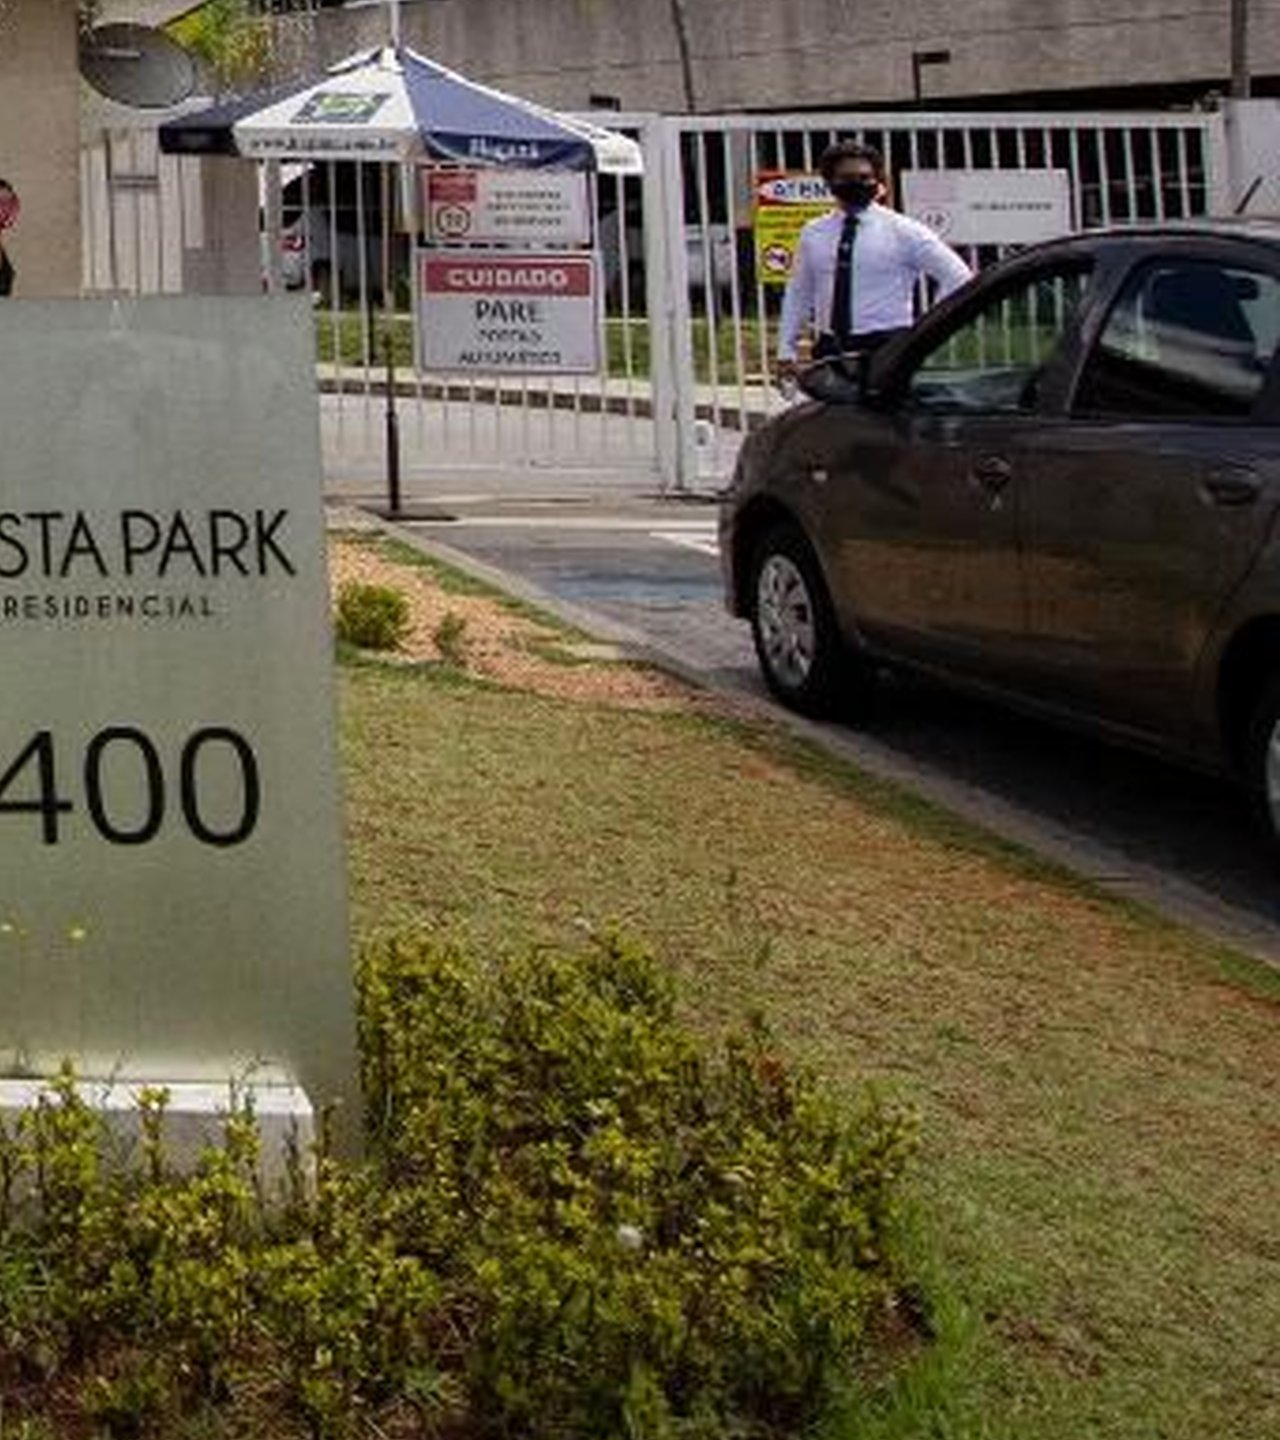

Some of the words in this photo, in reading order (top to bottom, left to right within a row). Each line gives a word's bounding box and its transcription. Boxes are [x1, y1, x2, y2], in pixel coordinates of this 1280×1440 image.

[447, 267, 569, 287] CUIDADO
[475, 299, 547, 323] PARE
[121, 508, 297, 578] PARK
[1, 594, 217, 620] RESIDENCIAL
